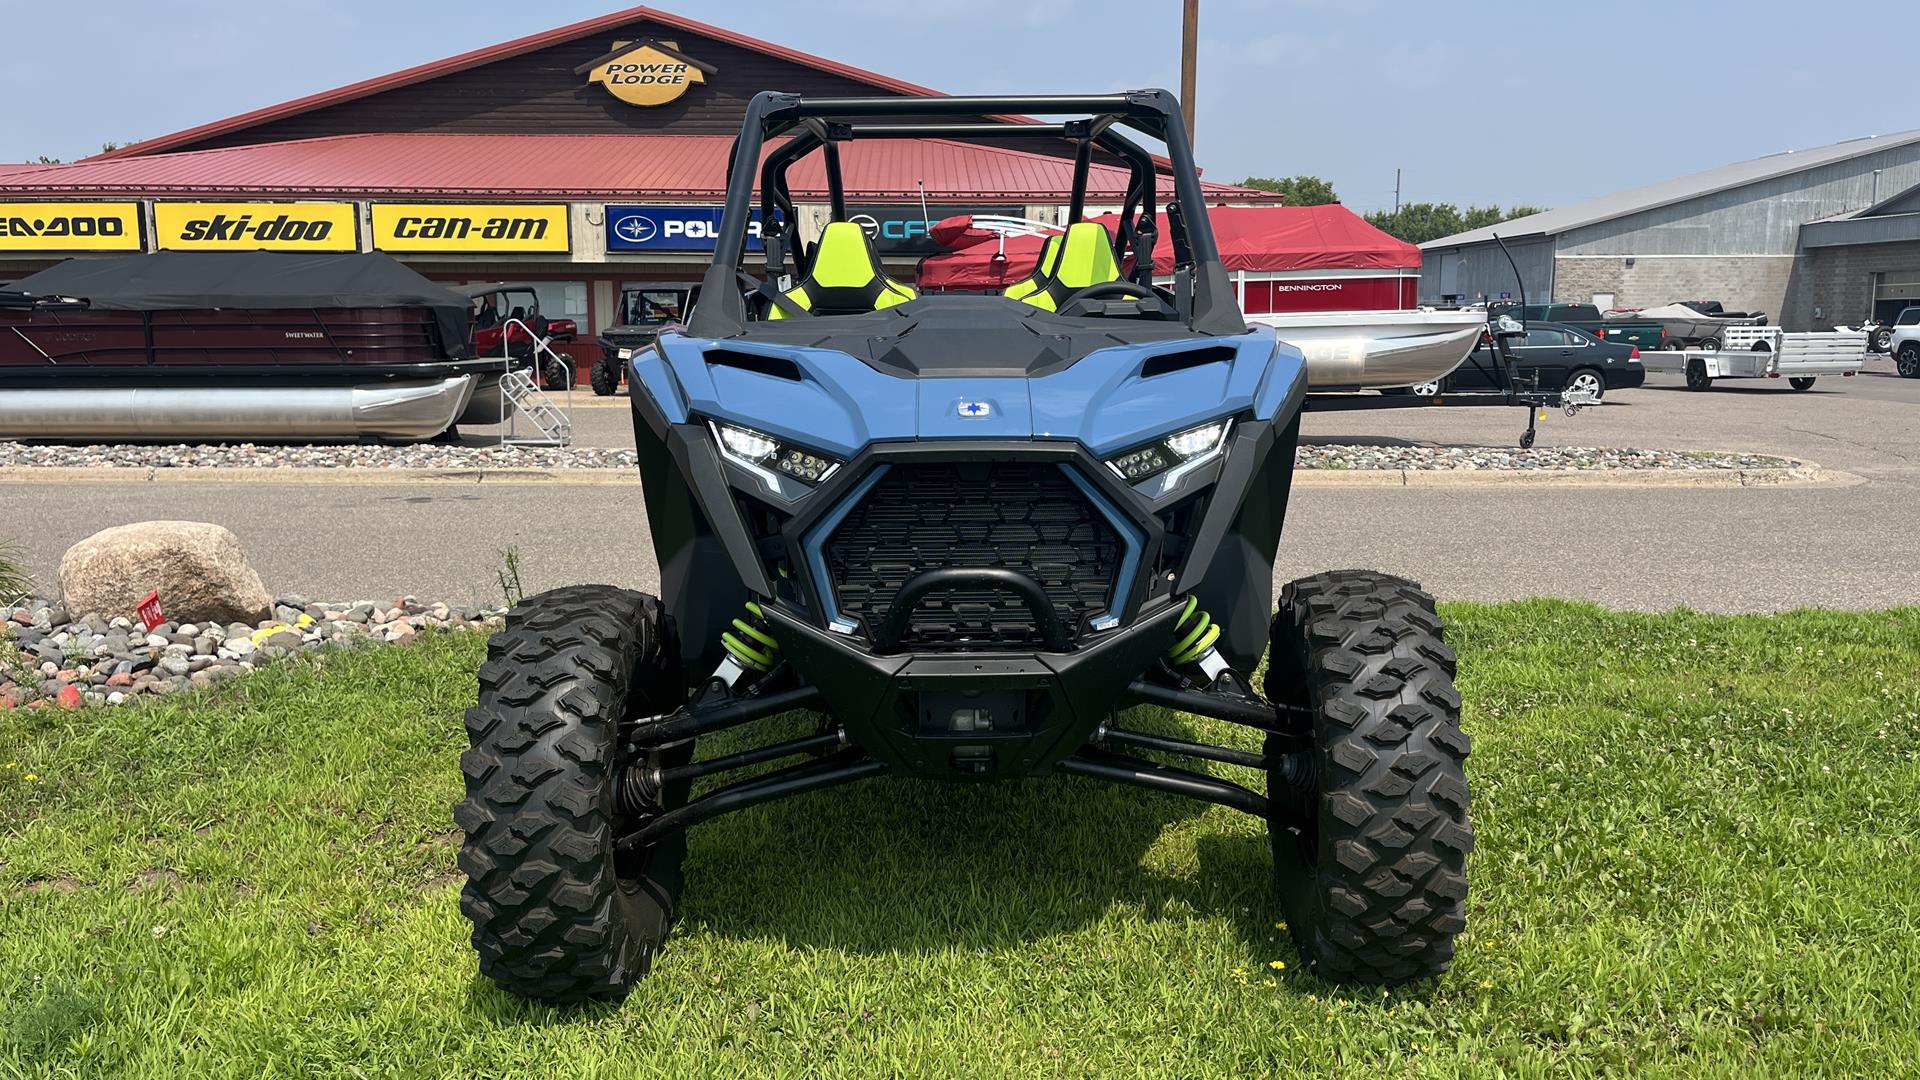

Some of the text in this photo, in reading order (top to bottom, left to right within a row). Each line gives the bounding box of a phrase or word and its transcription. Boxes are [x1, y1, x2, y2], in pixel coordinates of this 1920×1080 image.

[605, 63, 688, 75] POWER
[610, 73, 685, 85] LODGE
[180, 214, 333, 241] ski-doo
[393, 217, 548, 240] can-am
[664, 220, 785, 238] POLR
[882, 220, 944, 239] CF
[1278, 284, 1342, 292] BENNINGTON
[285, 331, 324, 339] SWEETWATER
